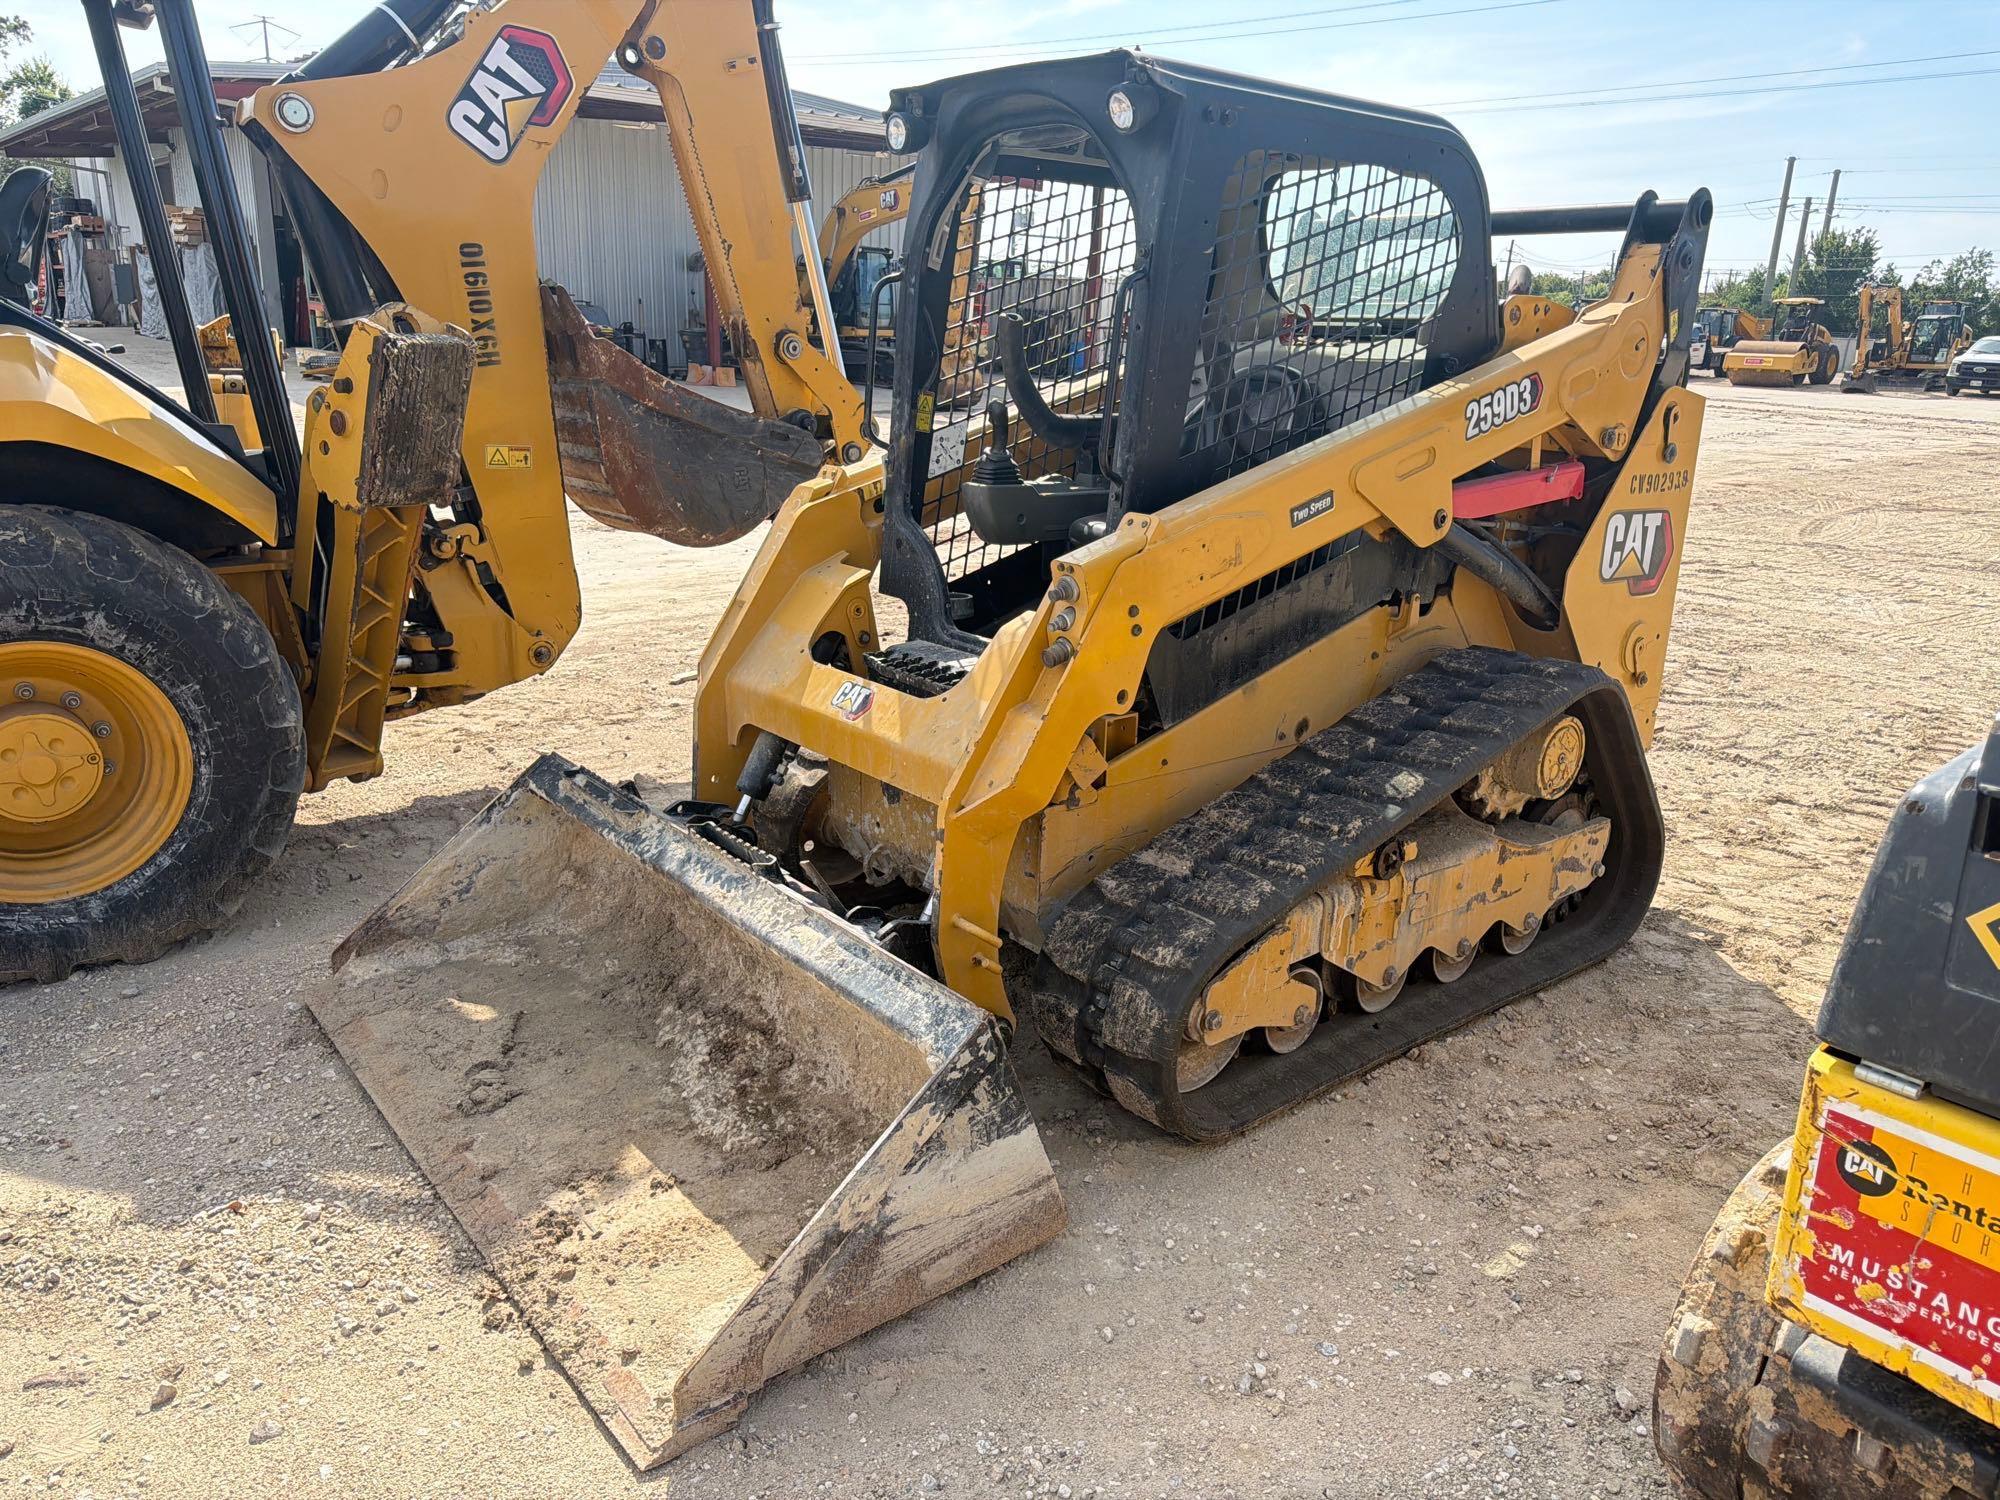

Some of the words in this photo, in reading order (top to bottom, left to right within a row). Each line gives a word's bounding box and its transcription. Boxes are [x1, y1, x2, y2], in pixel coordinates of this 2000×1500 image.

[450, 37, 546, 160] CAT
[880, 189, 895, 209] CAT
[459, 242, 501, 367] H9X01910
[1466, 378, 1532, 439] 259D3
[1293, 507, 1309, 523] TWO
[1310, 497, 1331, 515] SPEED
[1601, 512, 1663, 579] CAT
[831, 681, 872, 713] CAT
[1844, 1150, 1884, 1185] CAT
[1901, 1200, 1991, 1256] SOR
[1829, 1264, 1898, 1303] RENL
[1907, 1301, 2000, 1354] SERVICES
[1831, 1244, 2000, 1338] MUSTANG
